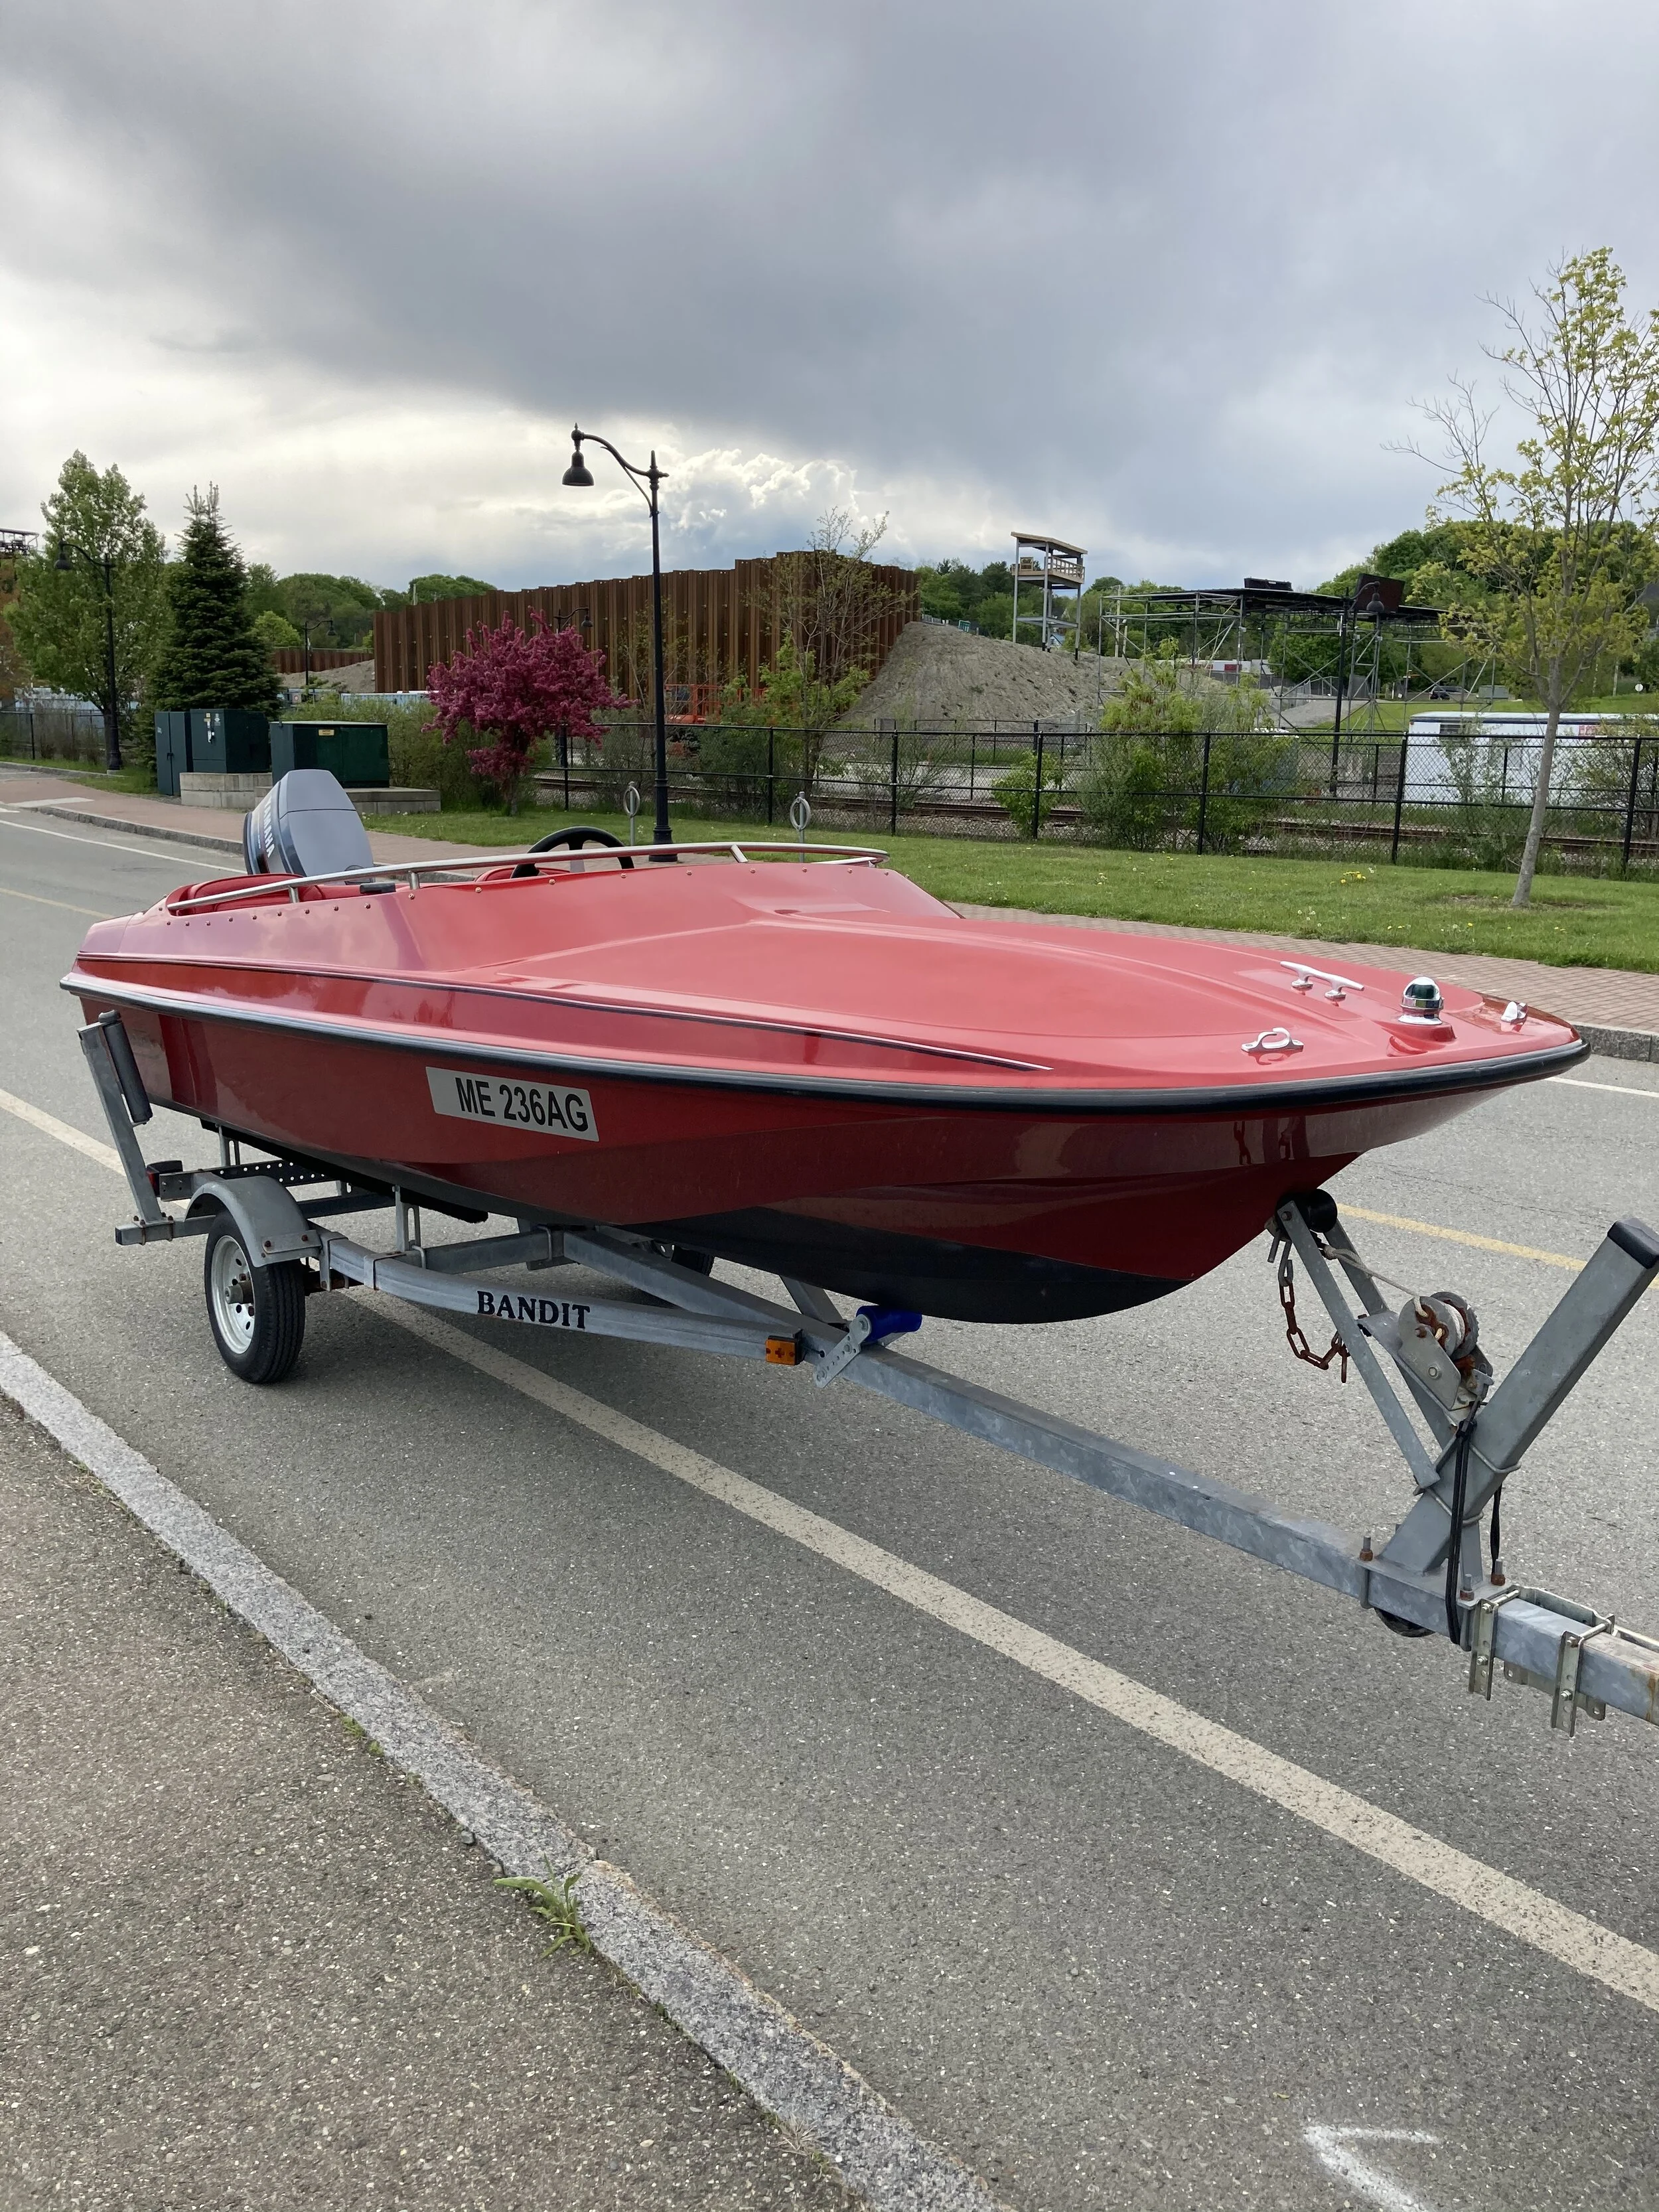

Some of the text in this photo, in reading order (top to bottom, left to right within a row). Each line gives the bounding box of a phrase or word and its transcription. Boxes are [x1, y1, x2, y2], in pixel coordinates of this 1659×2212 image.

[264, 796, 275, 858] YAMAHA
[455, 1077, 589, 1132] ME 236AG
[477, 1290, 590, 1329] BANDIT
